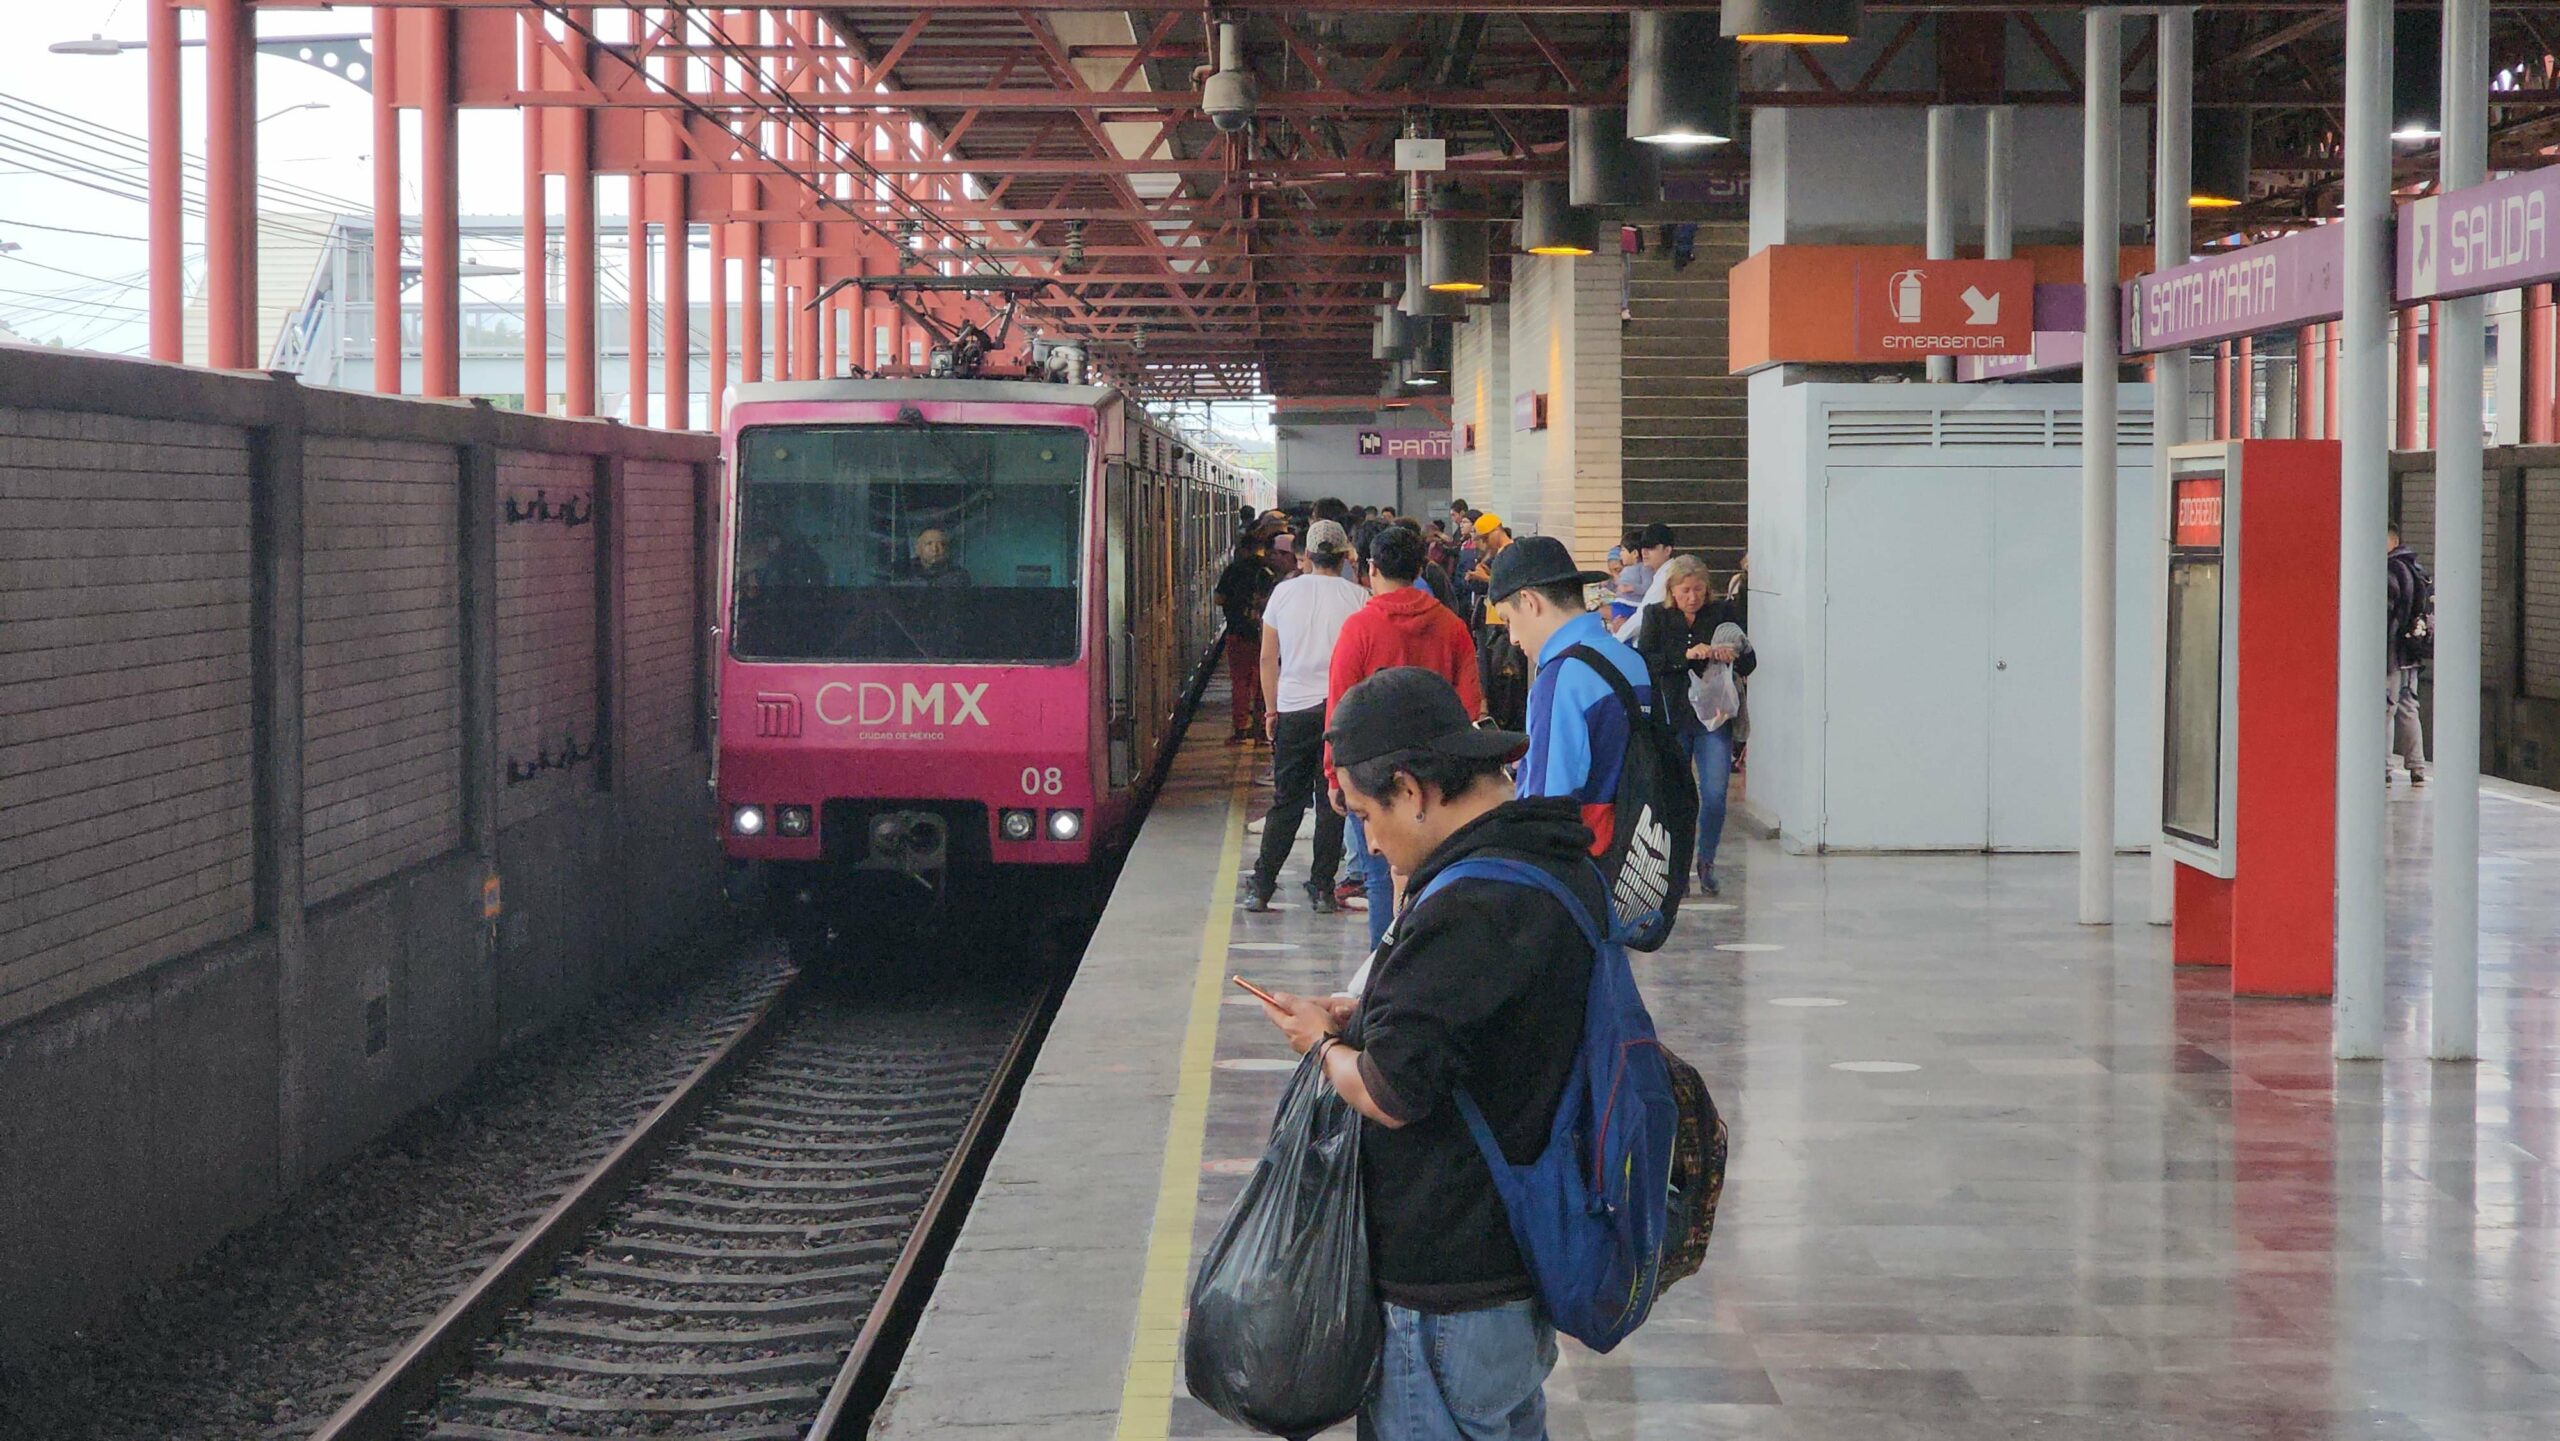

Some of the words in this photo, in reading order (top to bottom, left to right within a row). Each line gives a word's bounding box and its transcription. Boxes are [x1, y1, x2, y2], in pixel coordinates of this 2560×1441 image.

[2451, 189, 2546, 277] SALIDA
[2150, 272, 2204, 337] SANTA
[2207, 254, 2277, 325] MARTA
[1882, 335, 2005, 349] EMERGENCIA
[815, 681, 990, 726] CDMX
[859, 731, 894, 740] CIUDAD
[895, 731, 909, 740] DE
[1021, 766, 1063, 796] 08
